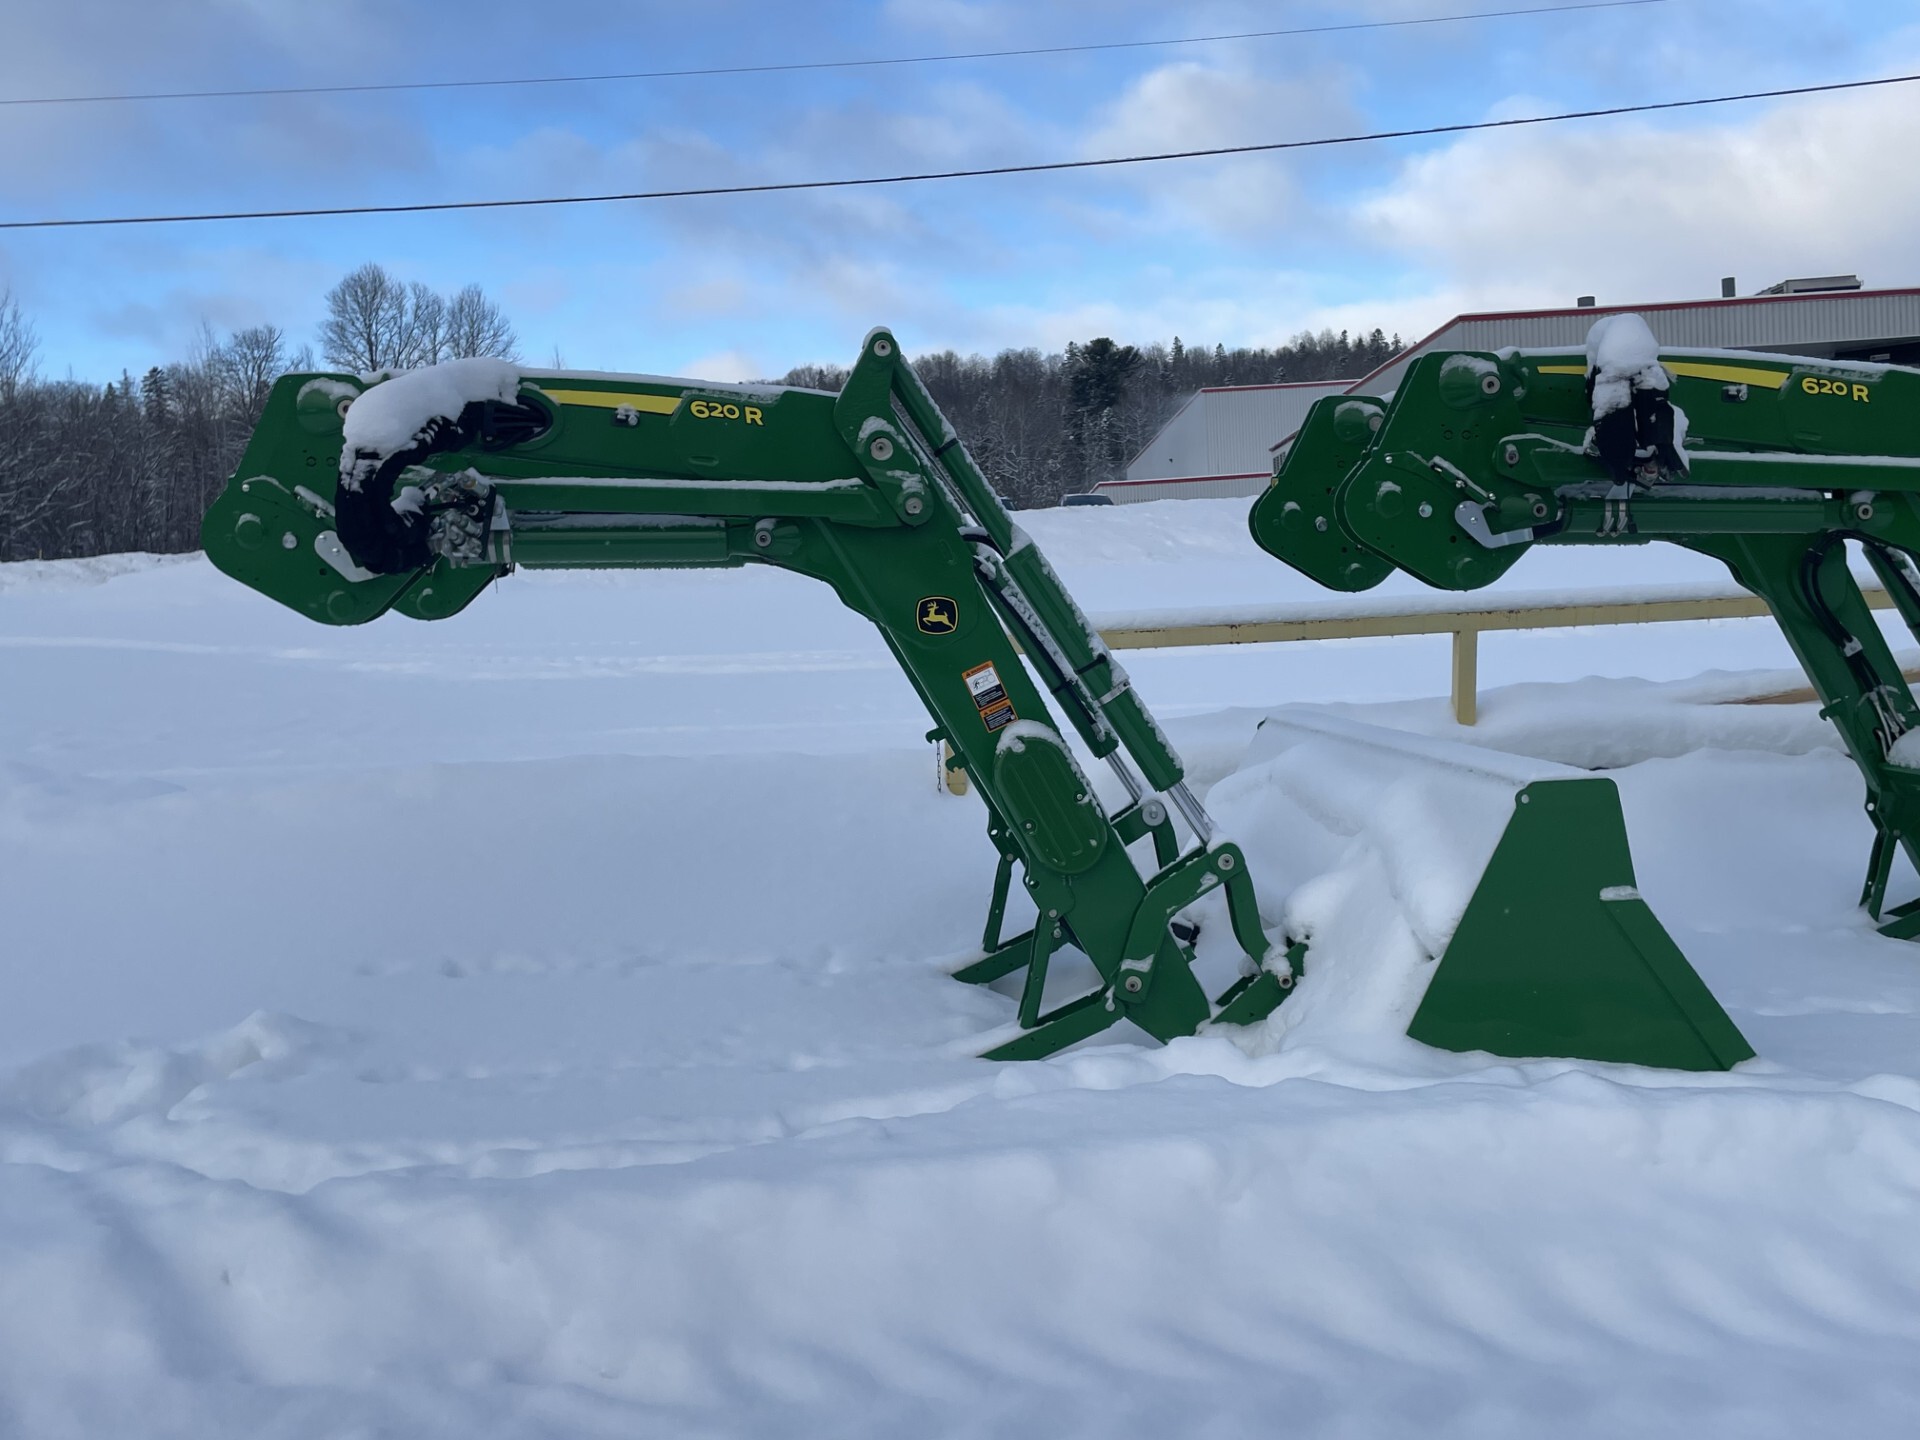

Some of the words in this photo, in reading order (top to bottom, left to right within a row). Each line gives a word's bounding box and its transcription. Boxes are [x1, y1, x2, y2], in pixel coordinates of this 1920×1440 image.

[1801, 377, 1848, 396] 620
[1852, 384, 1870, 403] R
[690, 400, 740, 419] 620
[744, 406, 764, 426] R
